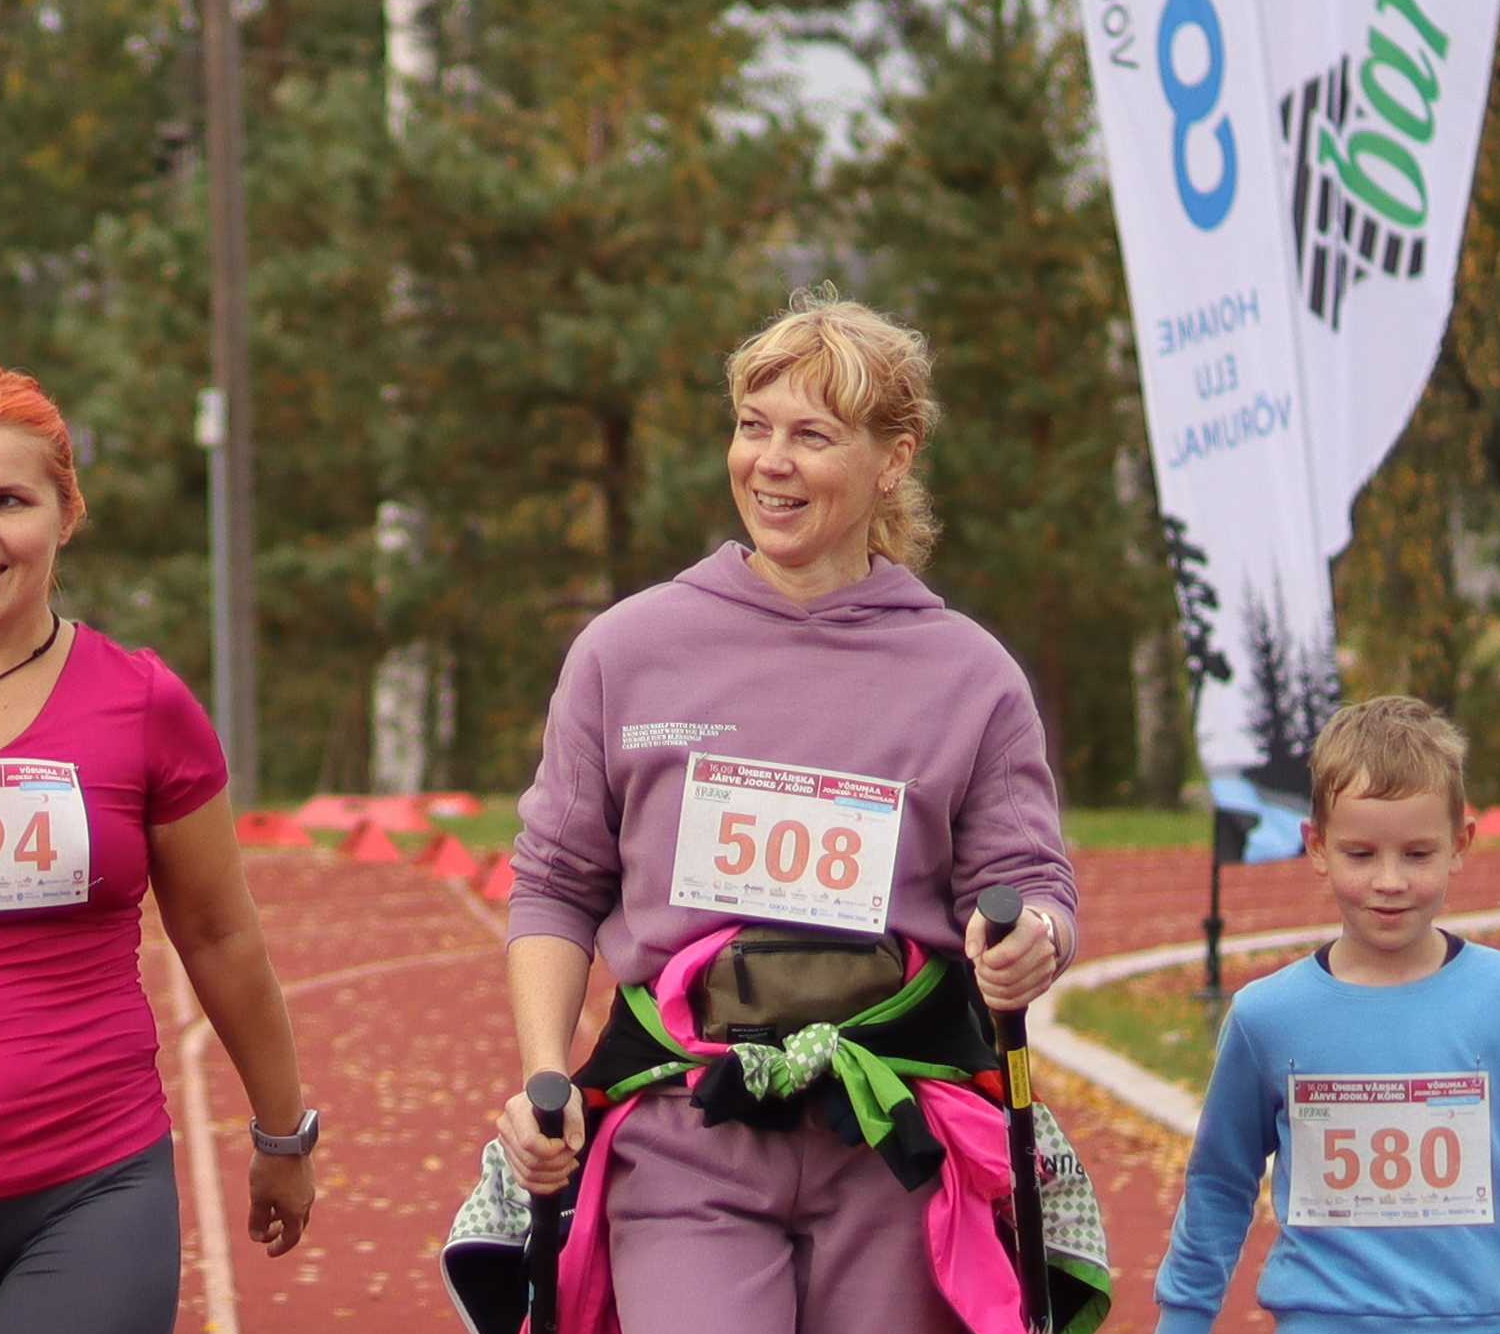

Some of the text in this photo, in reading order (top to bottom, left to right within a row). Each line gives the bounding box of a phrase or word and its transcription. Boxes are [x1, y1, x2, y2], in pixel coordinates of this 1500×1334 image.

[709, 773, 742, 784] JÄRVE
[743, 778, 776, 788] JOOKS
[784, 782, 814, 794] KÕND
[737, 766, 772, 778] ÜMBER
[774, 772, 815, 785] VÄRSKA
[714, 812, 862, 890] 508
[1309, 1092, 1336, 1101] JÄRVE
[1338, 1092, 1368, 1101] JOOKS
[1377, 1091, 1405, 1100] KÕND
[1332, 1083, 1362, 1091] ÜMBER
[1365, 1082, 1405, 1091] VÄRSKA
[1323, 1126, 1461, 1190] 580
